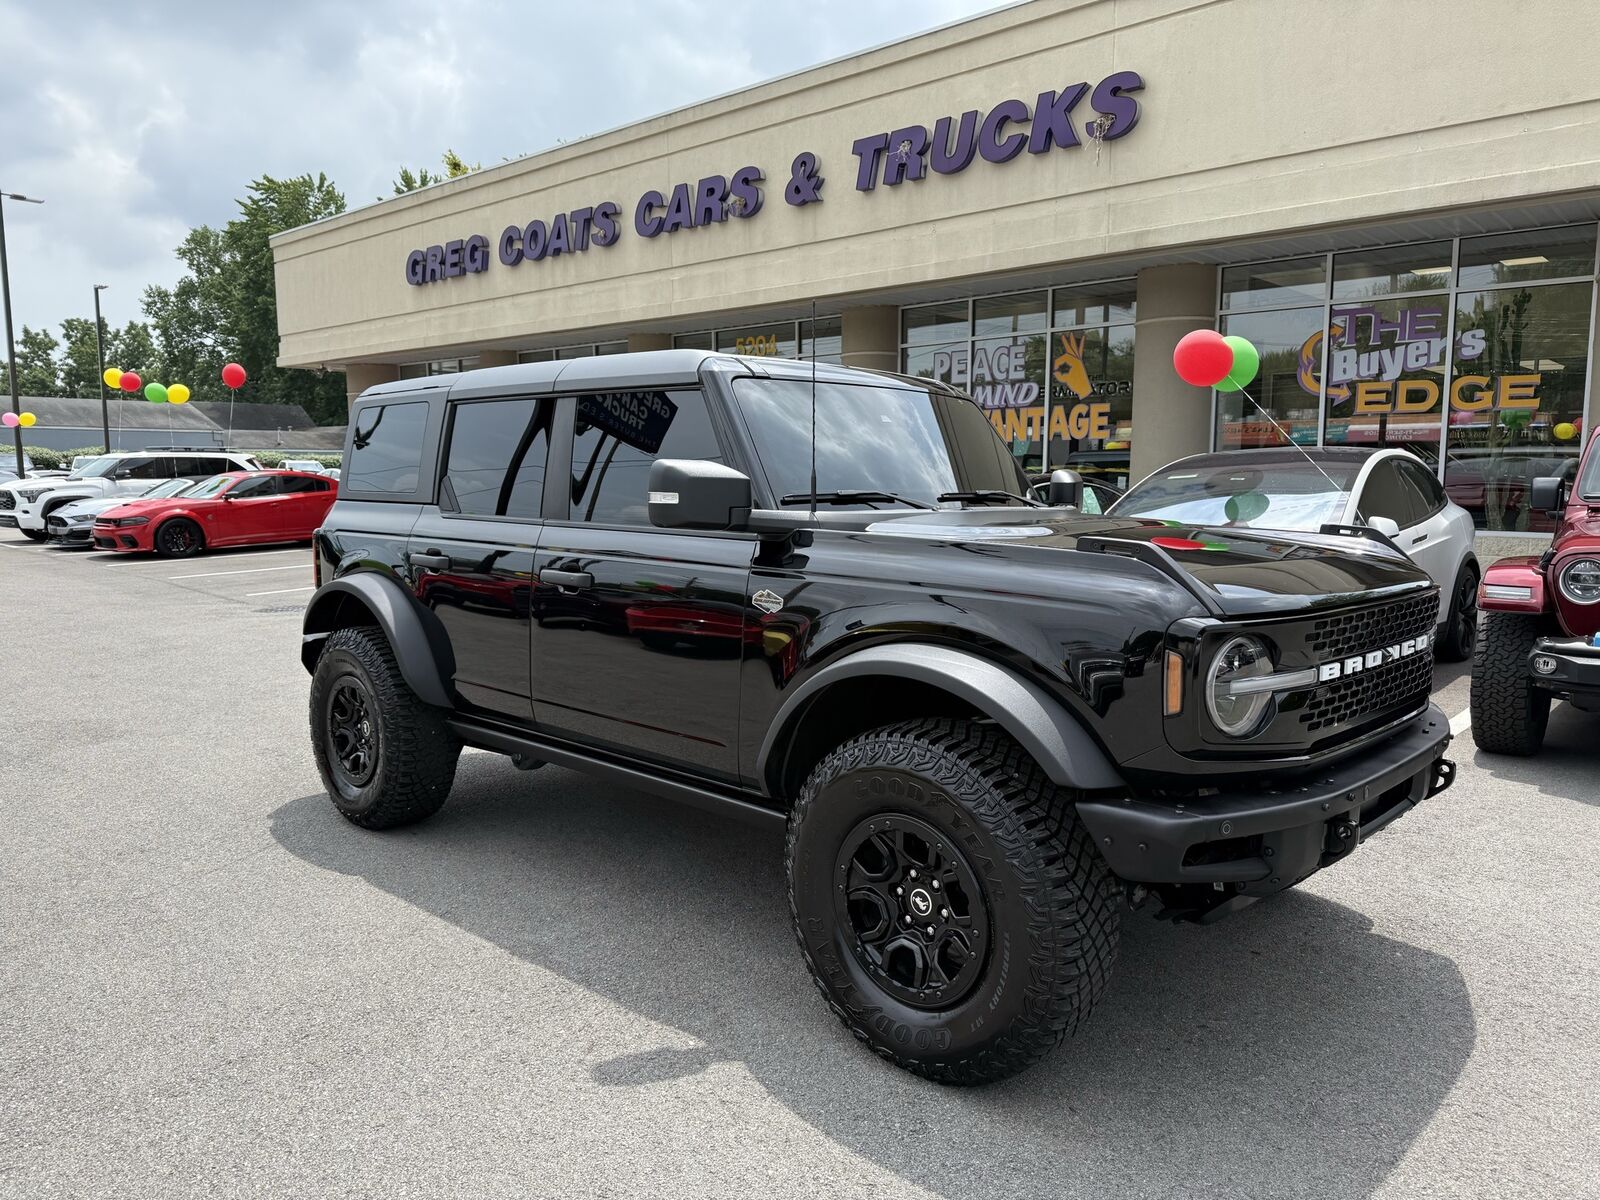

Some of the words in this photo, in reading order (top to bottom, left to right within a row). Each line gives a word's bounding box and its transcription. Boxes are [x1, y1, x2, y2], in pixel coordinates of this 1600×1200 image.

[405, 234, 490, 286] GREG
[499, 202, 622, 267] COATS
[635, 166, 766, 238] CARS
[785, 151, 823, 207] &
[851, 71, 1145, 192] TRUCKS
[735, 334, 778, 356] 5204
[1331, 306, 1442, 348] THE
[933, 344, 1026, 385] PEACE
[973, 381, 1040, 410] MIND
[1354, 373, 1542, 415] EDGE
[1320, 634, 1428, 682] BRONCO
